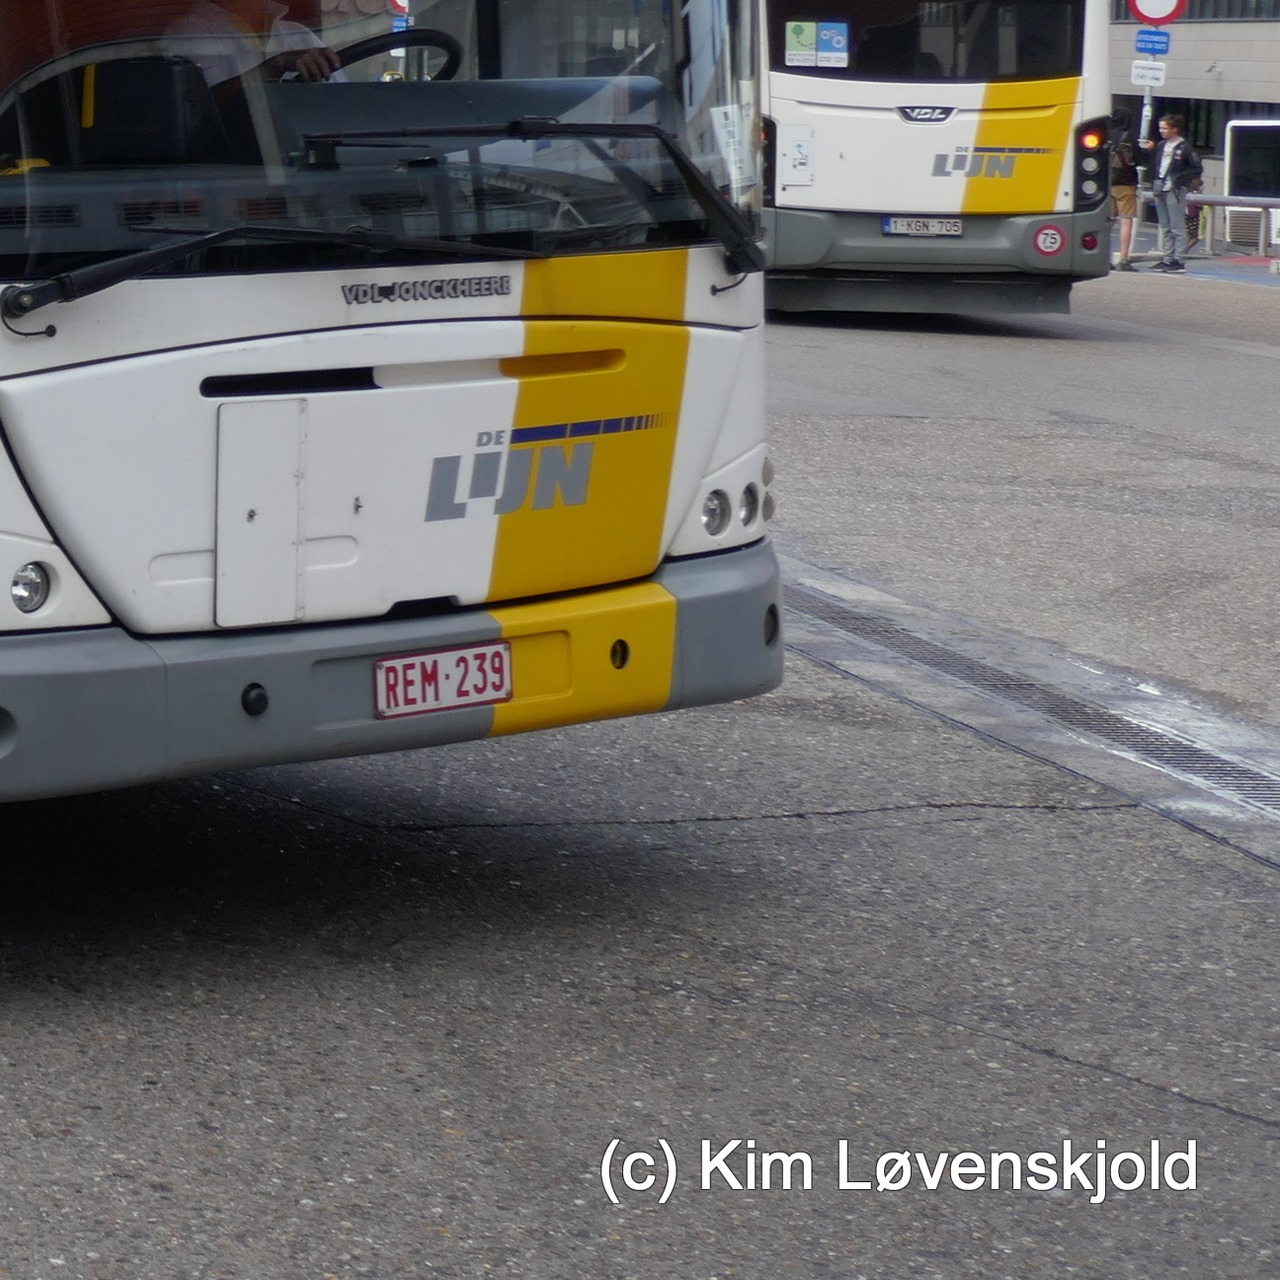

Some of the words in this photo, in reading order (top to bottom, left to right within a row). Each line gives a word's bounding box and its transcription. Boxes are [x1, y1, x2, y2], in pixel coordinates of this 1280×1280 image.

[904, 107, 948, 119] VDL
[931, 153, 1017, 179] LIJN
[1042, 232, 1058, 245] 75
[342, 282, 385, 304] VDL
[389, 276, 511, 302] JONCKHEERE
[475, 429, 506, 448] DE
[424, 441, 596, 523] LIJN
